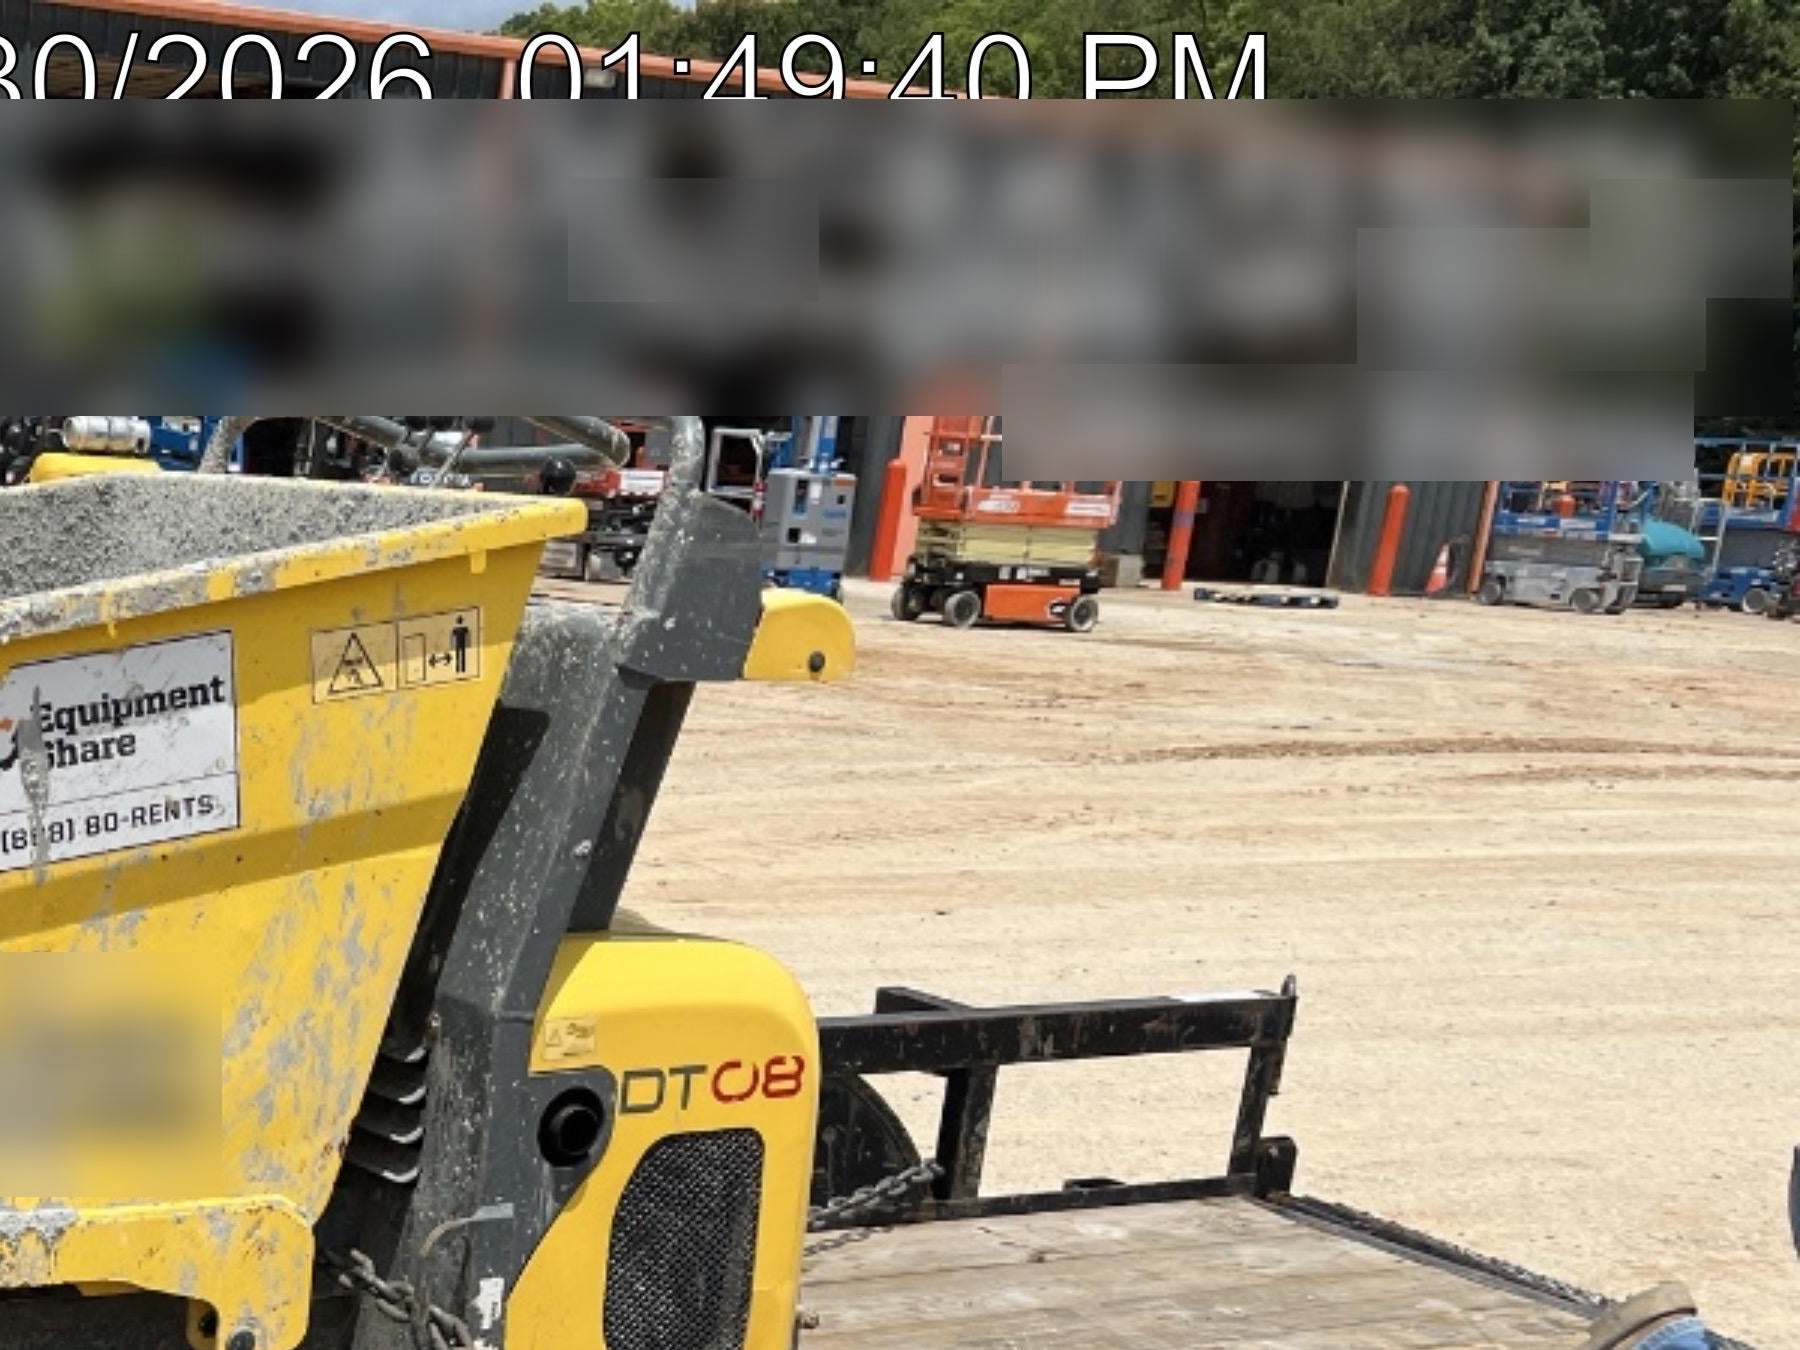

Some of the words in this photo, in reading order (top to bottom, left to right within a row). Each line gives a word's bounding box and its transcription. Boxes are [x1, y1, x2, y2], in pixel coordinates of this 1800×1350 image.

[30, 675, 226, 736] Equipment
[85, 795, 215, 838] 80-RENTS
[619, 1055, 805, 1114] DT08
